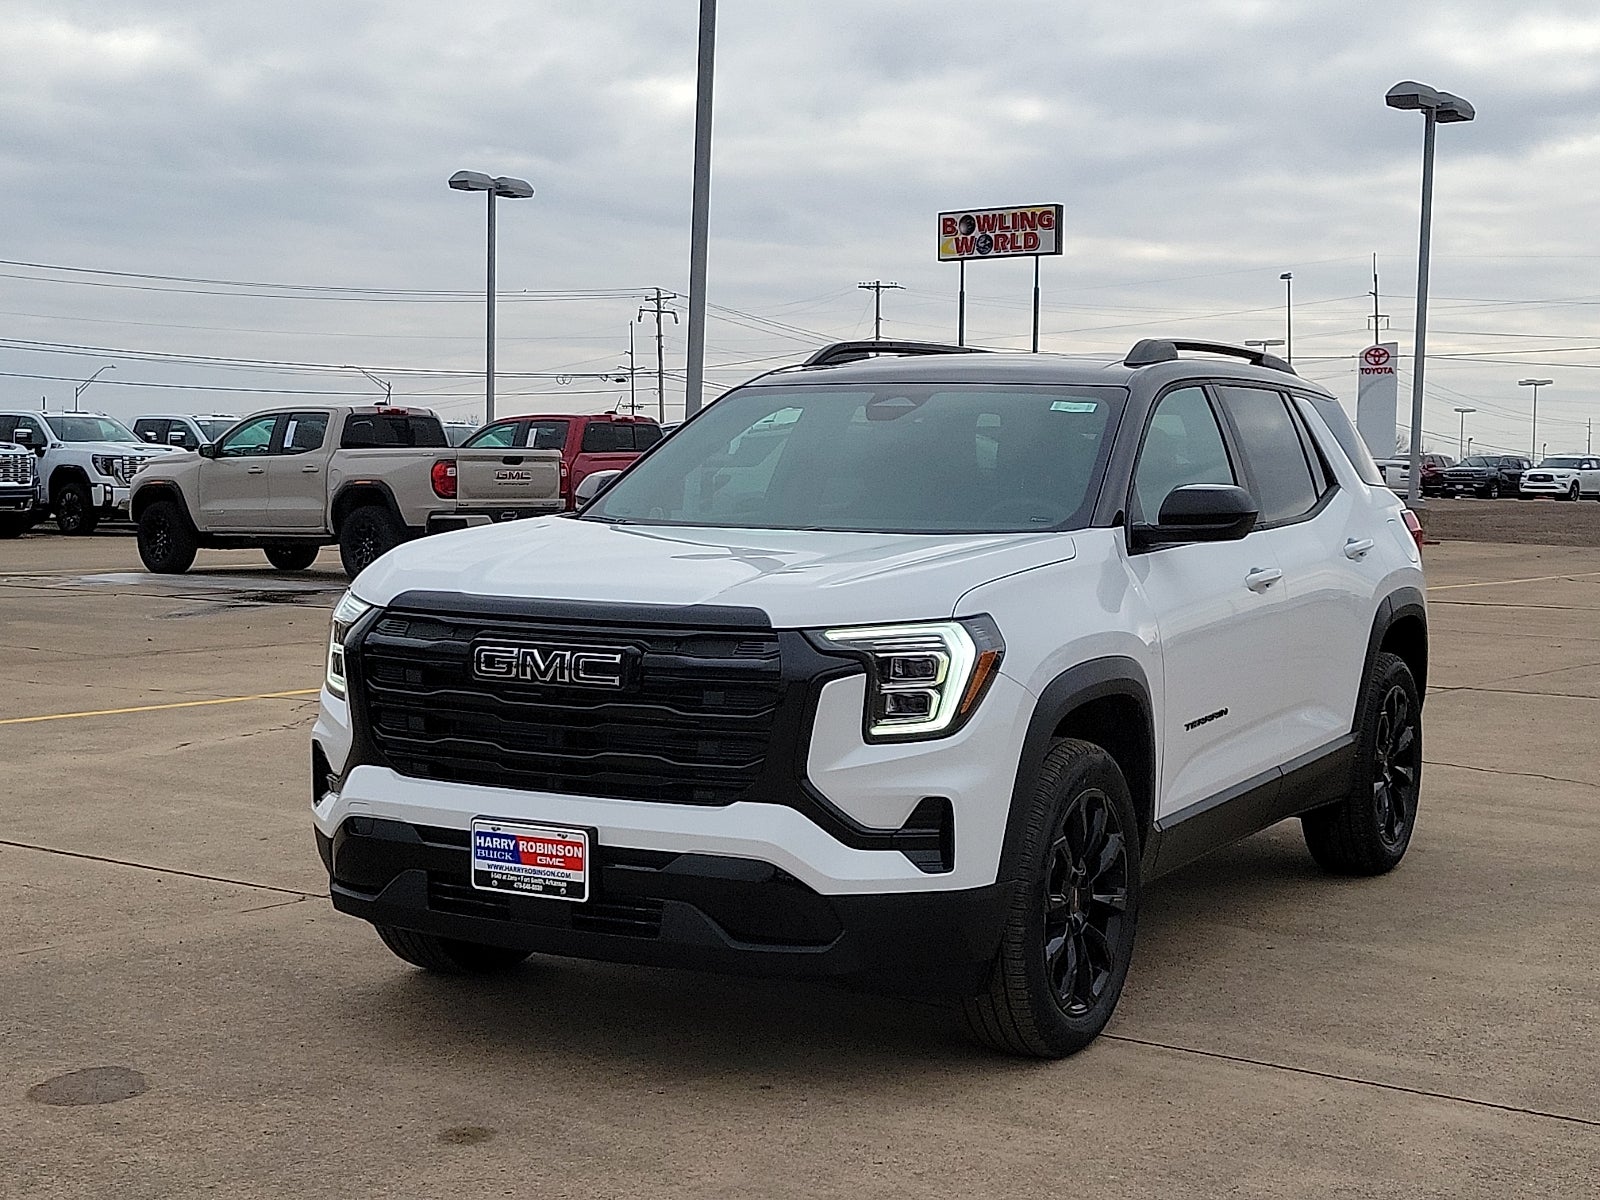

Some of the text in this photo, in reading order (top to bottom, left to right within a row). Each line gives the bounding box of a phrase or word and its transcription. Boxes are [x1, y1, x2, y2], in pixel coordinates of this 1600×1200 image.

[942, 210, 1055, 237] BOWLING
[954, 232, 1041, 256] WORLD
[1360, 367, 1394, 375] TOYOTA
[495, 470, 532, 481] GMC
[474, 645, 622, 686] GMC
[476, 836, 582, 858] HARRY ROBINSON
[477, 848, 514, 860] BUICK
[536, 856, 566, 867] GMC
[487, 863, 572, 879] WWW.HARRYROBINSON.COM
